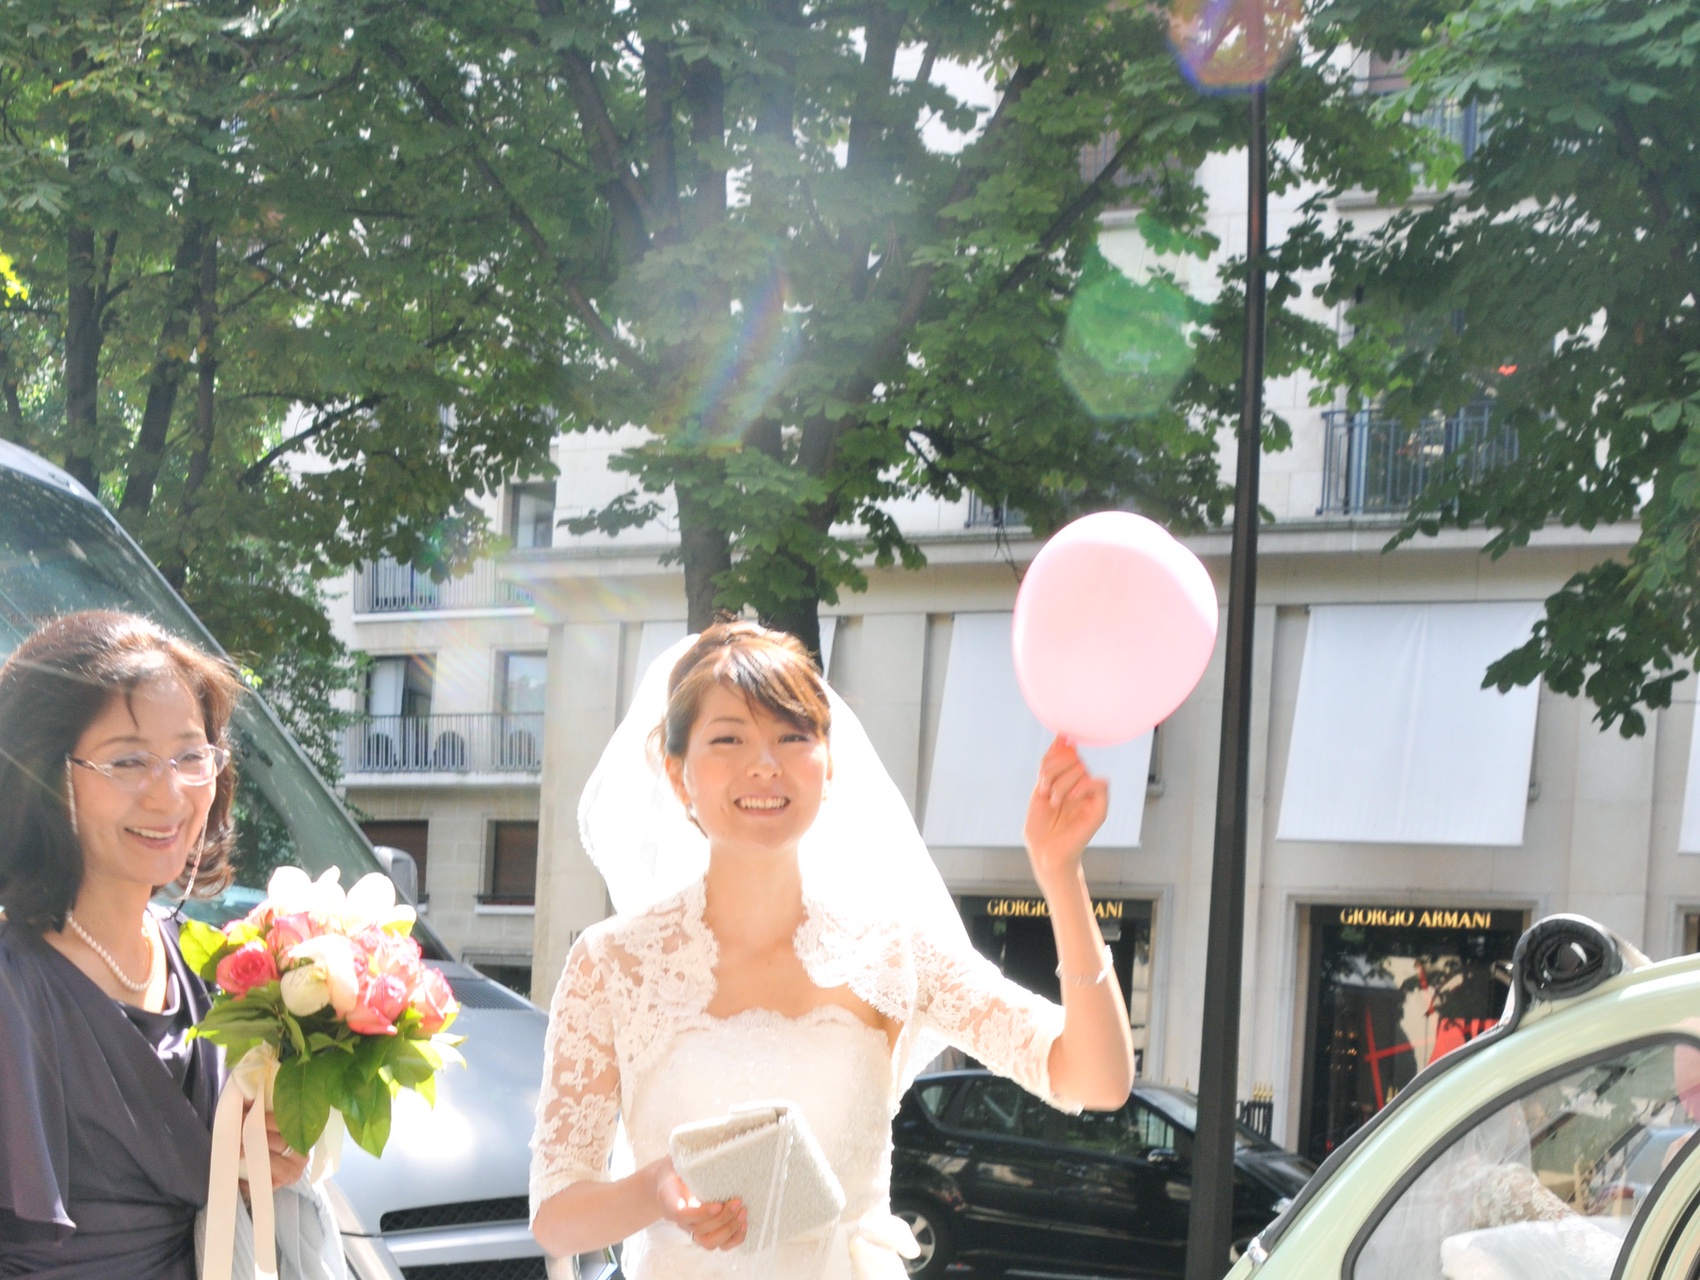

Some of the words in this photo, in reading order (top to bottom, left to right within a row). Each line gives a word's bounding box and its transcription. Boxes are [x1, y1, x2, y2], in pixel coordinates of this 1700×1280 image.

[1090, 901, 1123, 918] ANI
[1340, 908, 1414, 926] GIORGIO
[1418, 911, 1491, 928] ARMANI
